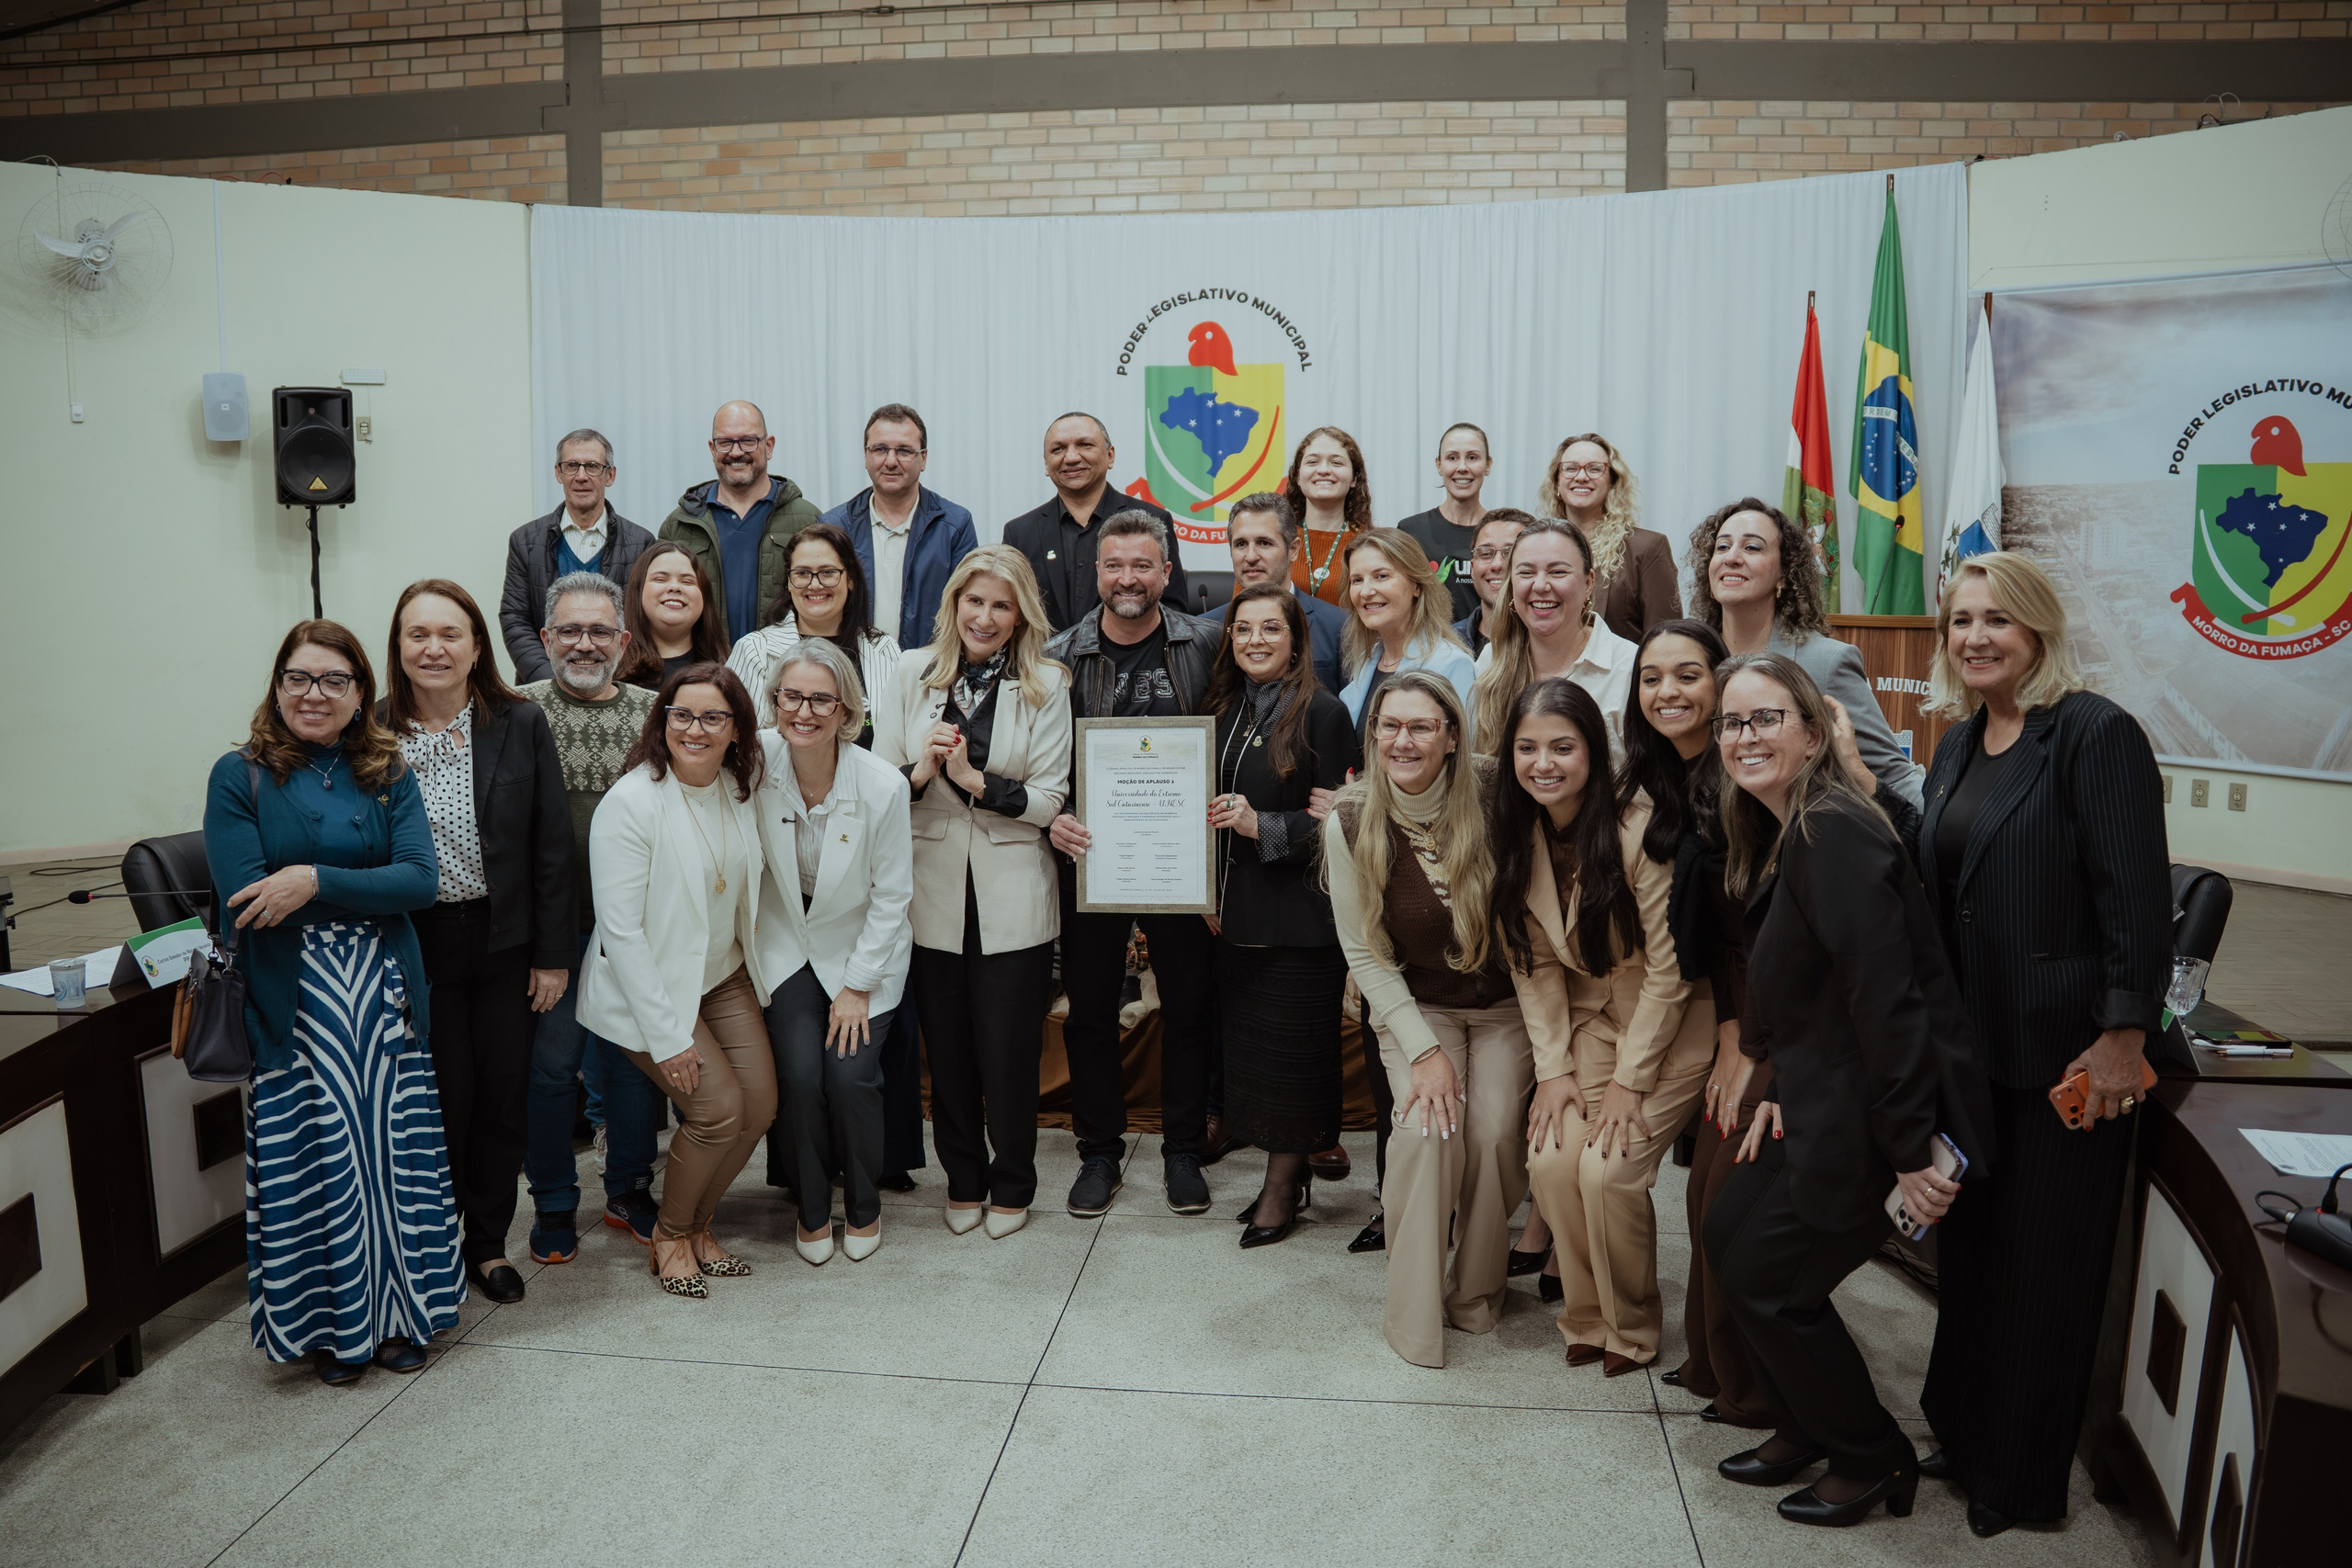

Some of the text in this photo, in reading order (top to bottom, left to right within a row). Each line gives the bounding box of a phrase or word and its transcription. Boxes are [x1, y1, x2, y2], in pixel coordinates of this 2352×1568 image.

[1116, 288, 1314, 376] PODER LEGISLATIVO MUNICIPAL
[2168, 416, 2205, 475] PODER
[2201, 378, 2324, 420] LEGISLATIVO
[1190, 530, 1208, 540] DA
[2192, 615, 2238, 649] MORRO
[2238, 642, 2258, 656] DA
[2260, 637, 2324, 657] FUMAÇA
[2331, 619, 2351, 637] SC
[1106, 800, 1117, 808] Sul
[1117, 799, 1150, 807] Catarinense
[1112, 789, 1182, 797] Universidade do Extremo
